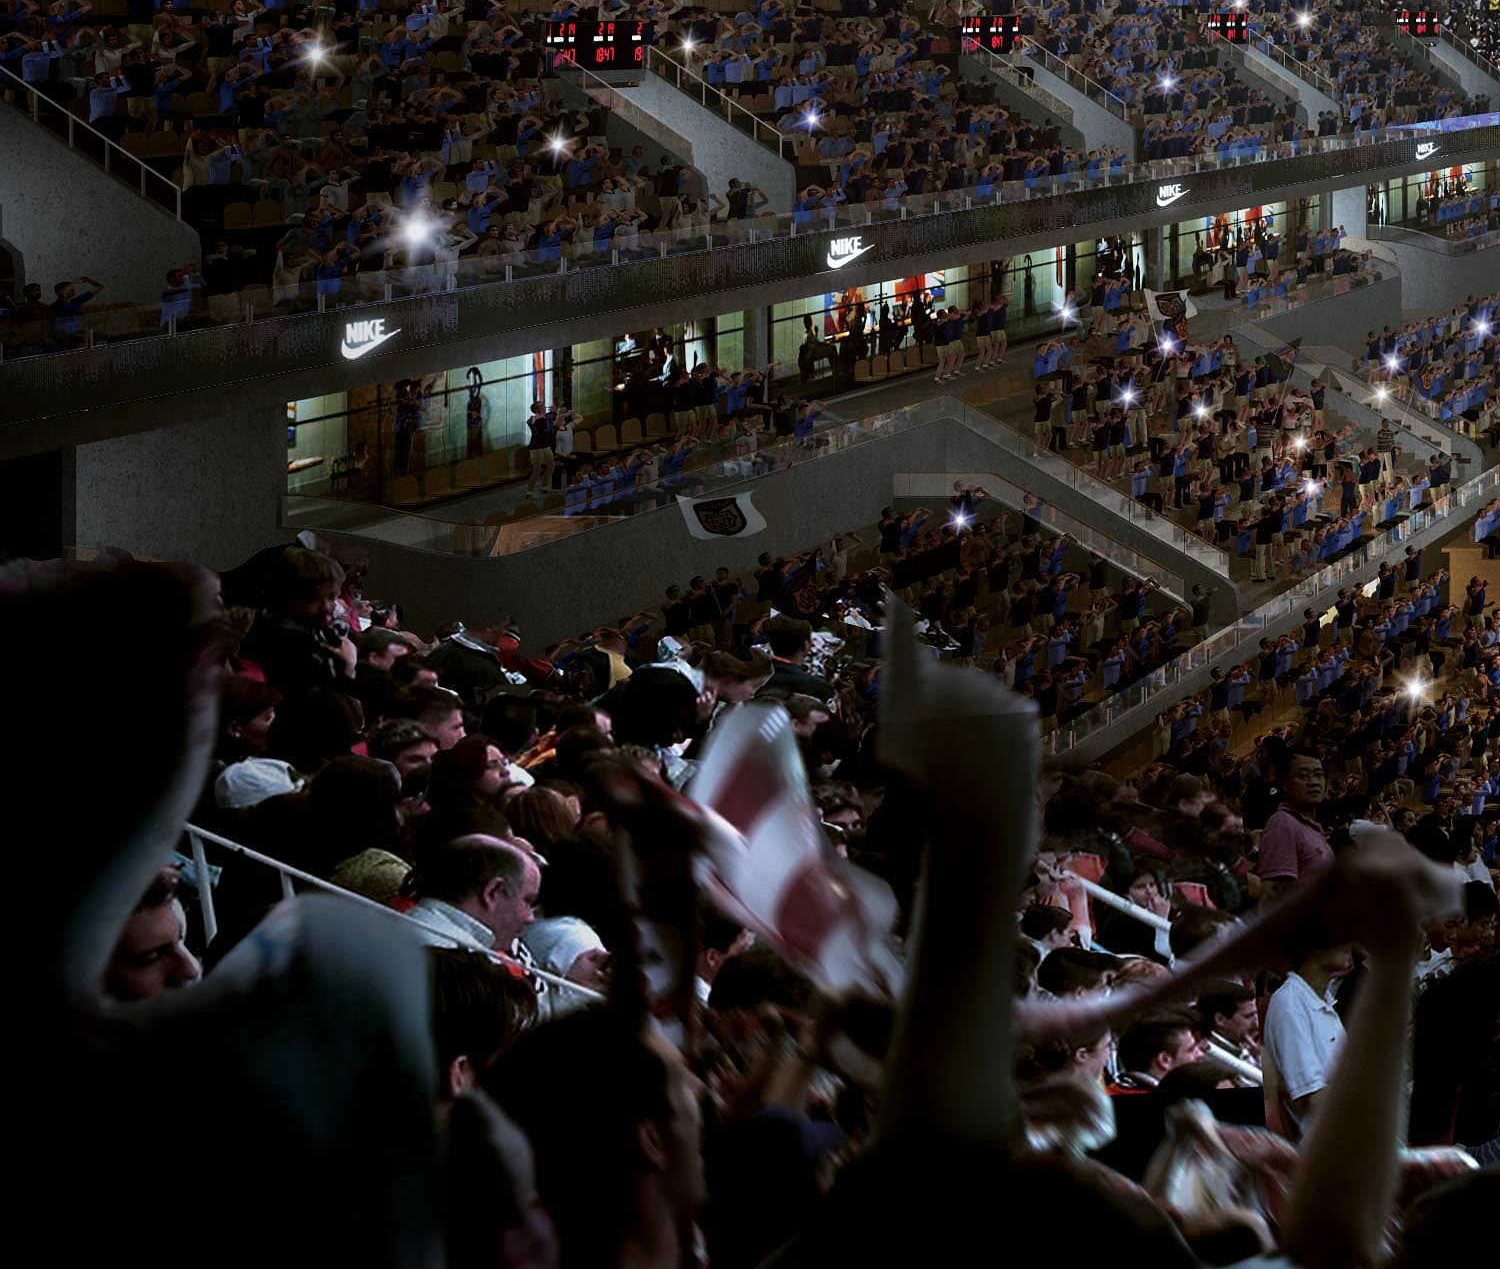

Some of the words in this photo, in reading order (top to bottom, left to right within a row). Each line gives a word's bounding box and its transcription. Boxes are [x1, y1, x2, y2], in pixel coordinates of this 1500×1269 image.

[1417, 142, 1435, 153] NIKE
[1159, 183, 1182, 198] NIKE
[831, 236, 862, 256] NIKE
[346, 318, 385, 343] NIKE
